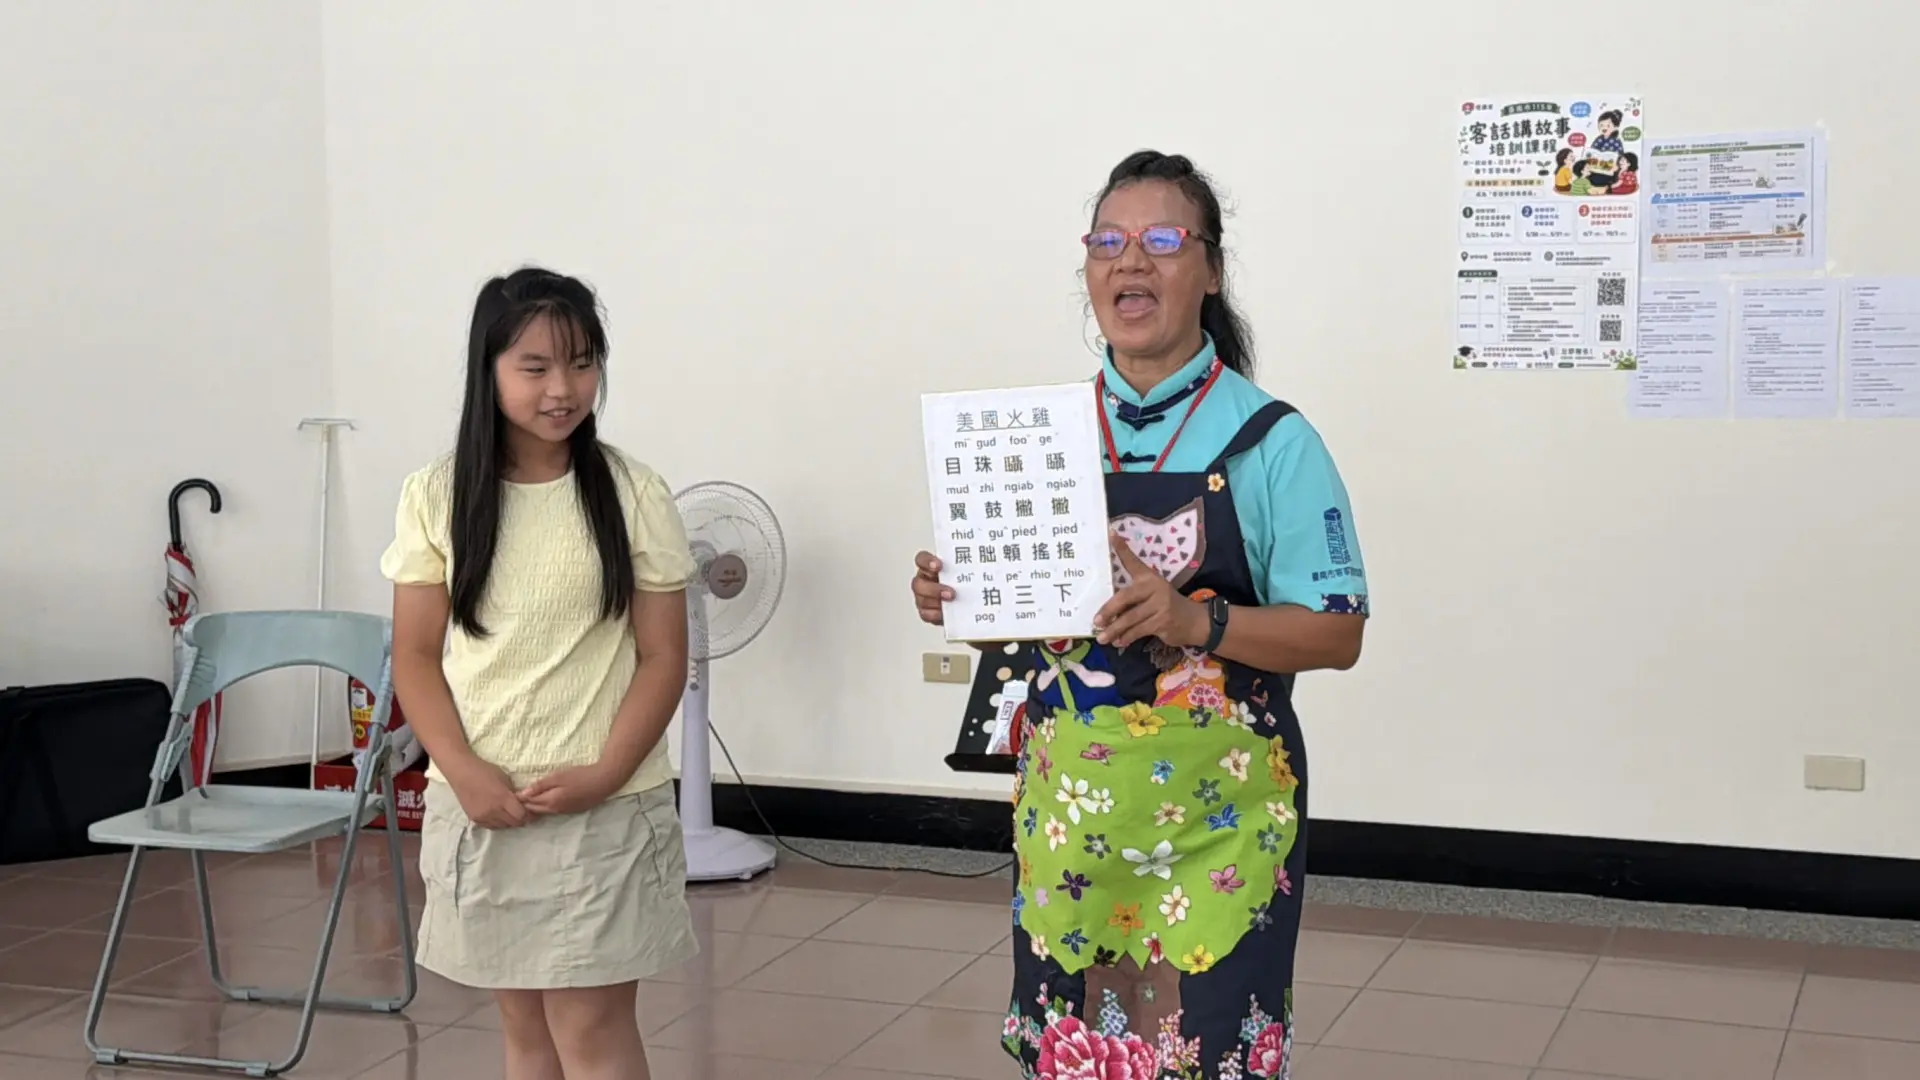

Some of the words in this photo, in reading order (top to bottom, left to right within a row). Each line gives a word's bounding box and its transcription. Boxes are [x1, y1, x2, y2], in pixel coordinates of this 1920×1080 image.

[1469, 117, 1571, 145] 客話講故事
[1489, 139, 1557, 156] 培訓課程
[956, 407, 1051, 432] 美國火雞
[982, 583, 1073, 606] 拍三下
